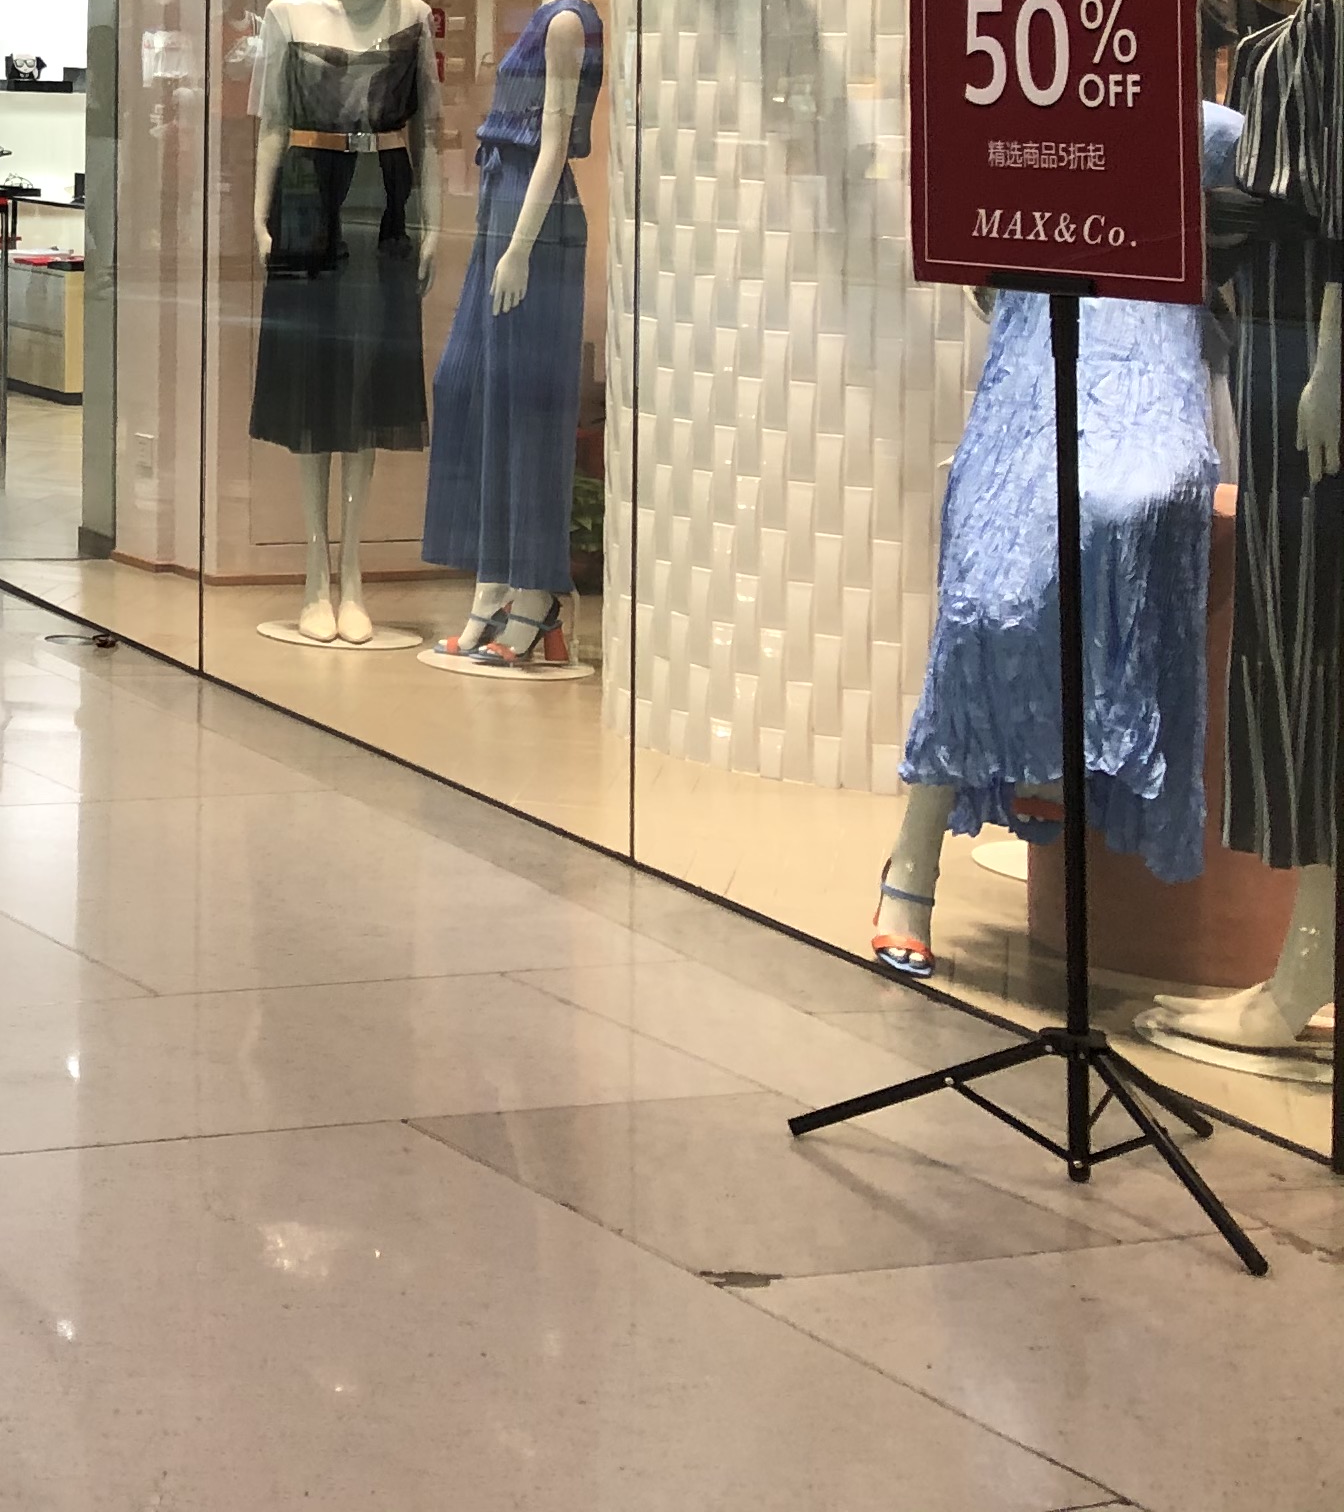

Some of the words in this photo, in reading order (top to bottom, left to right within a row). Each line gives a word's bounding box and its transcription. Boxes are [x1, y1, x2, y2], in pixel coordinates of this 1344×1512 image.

[1078, 74, 1141, 108] OFF
[987, 139, 1106, 171] 精选商品5折起
[971, 207, 1138, 248] MAX&Co.
